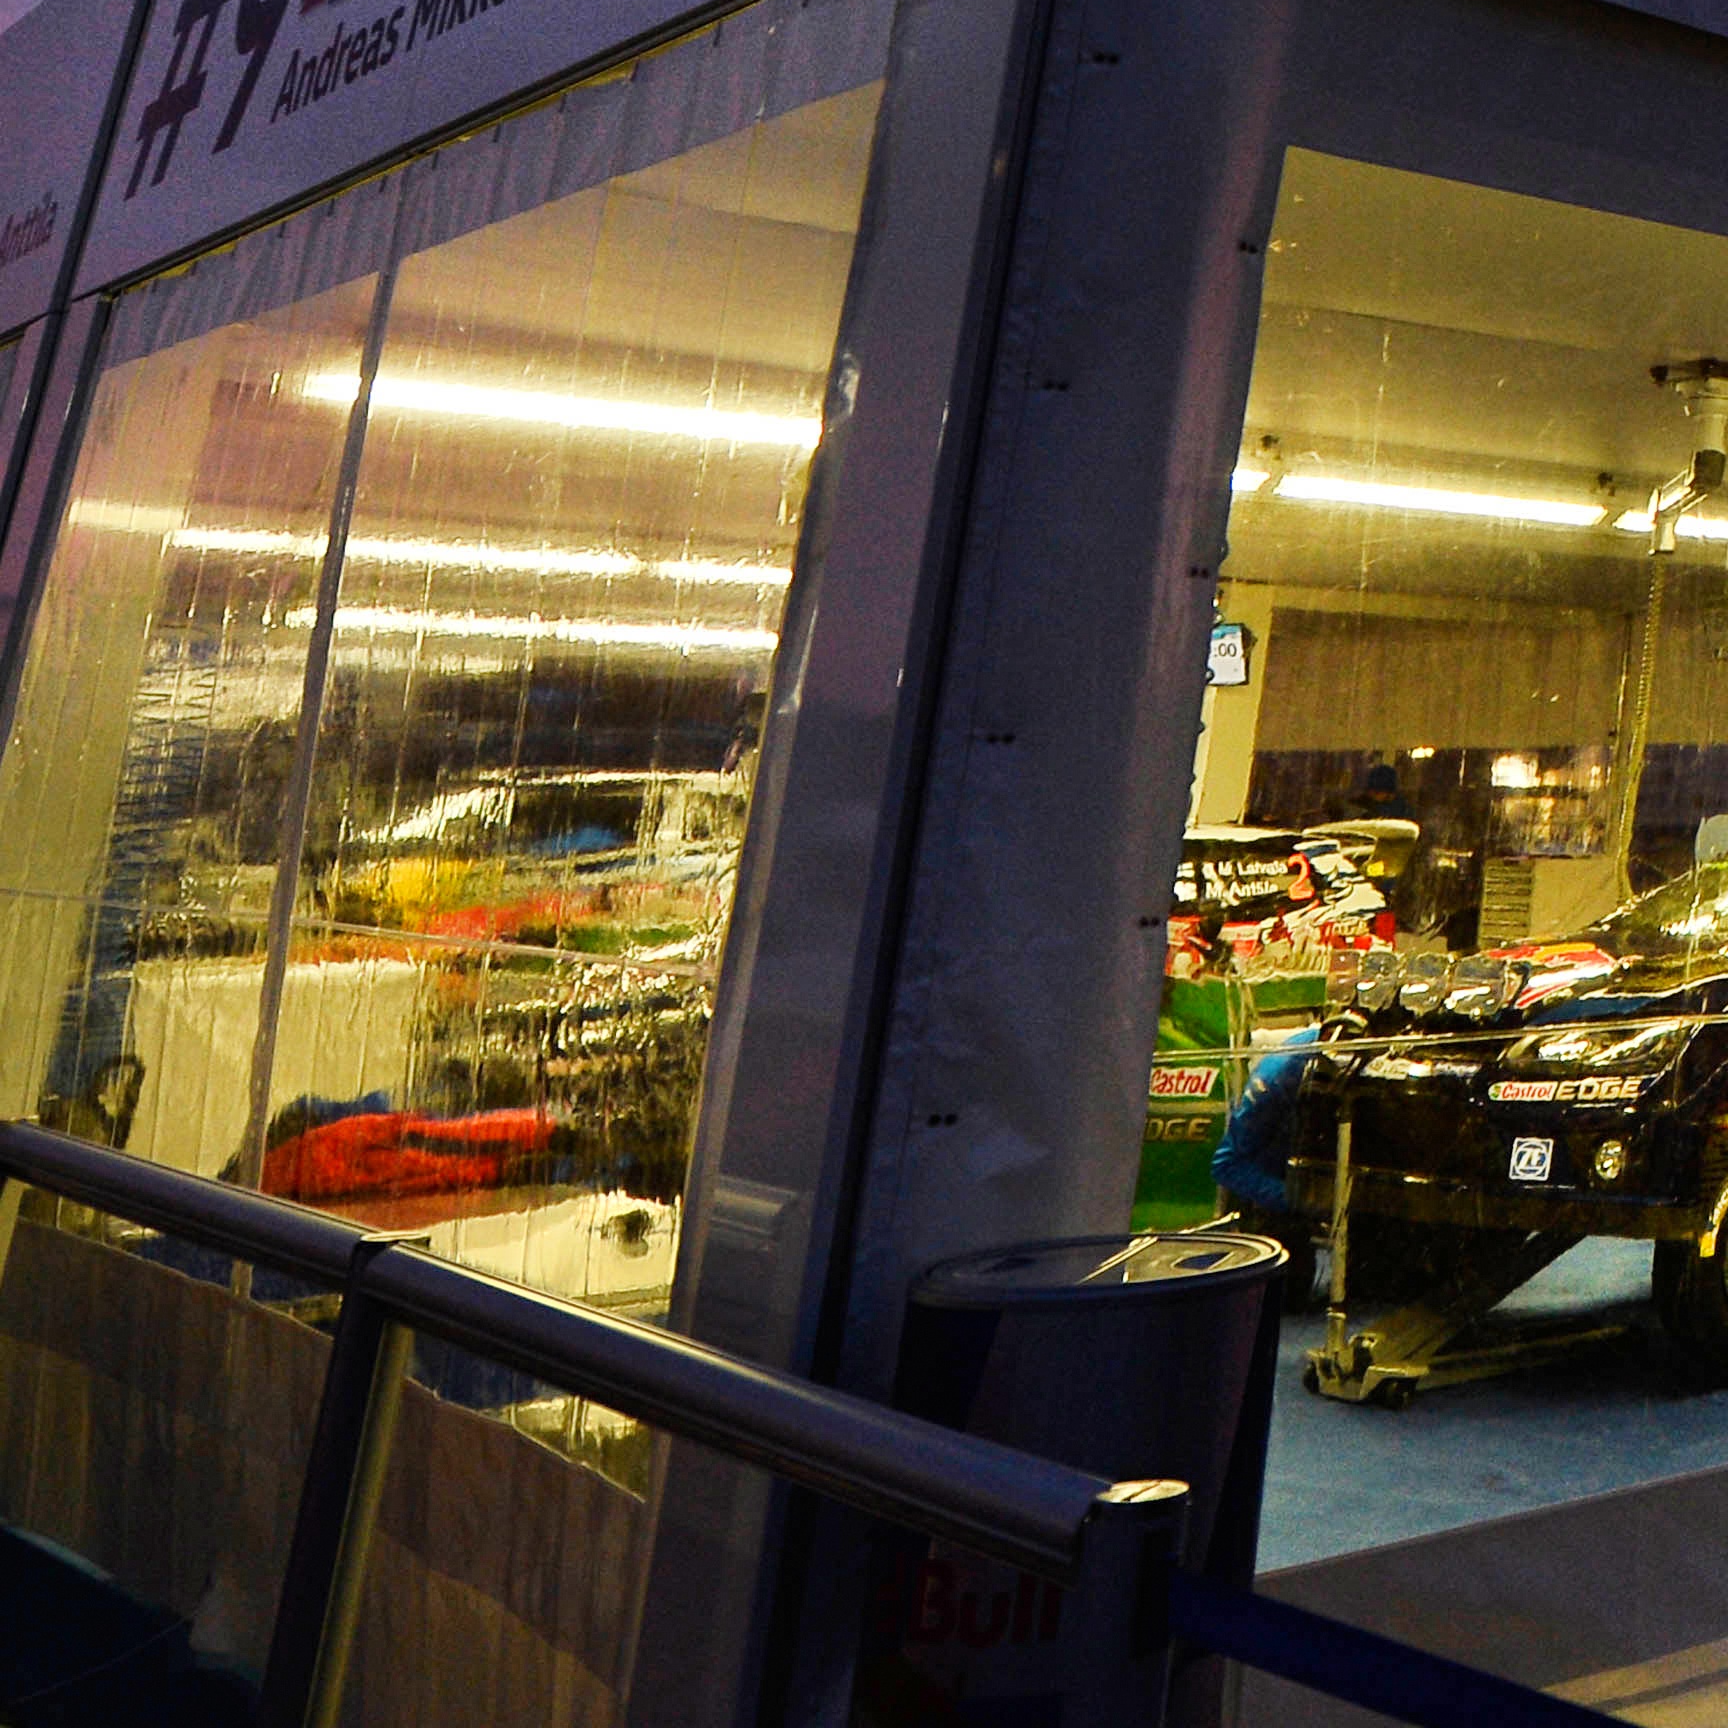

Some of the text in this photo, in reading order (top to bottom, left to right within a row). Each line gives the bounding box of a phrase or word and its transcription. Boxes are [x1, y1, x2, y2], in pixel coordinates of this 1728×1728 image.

[271, 5, 405, 123] Andreas
[1288, 853, 1315, 901] 2
[1151, 1068, 1212, 1094] Castrol
[1501, 1079, 1641, 1101] Castrol EDGE
[1145, 1117, 1212, 1141] DGE
[908, 1559, 1061, 1647] Bull
